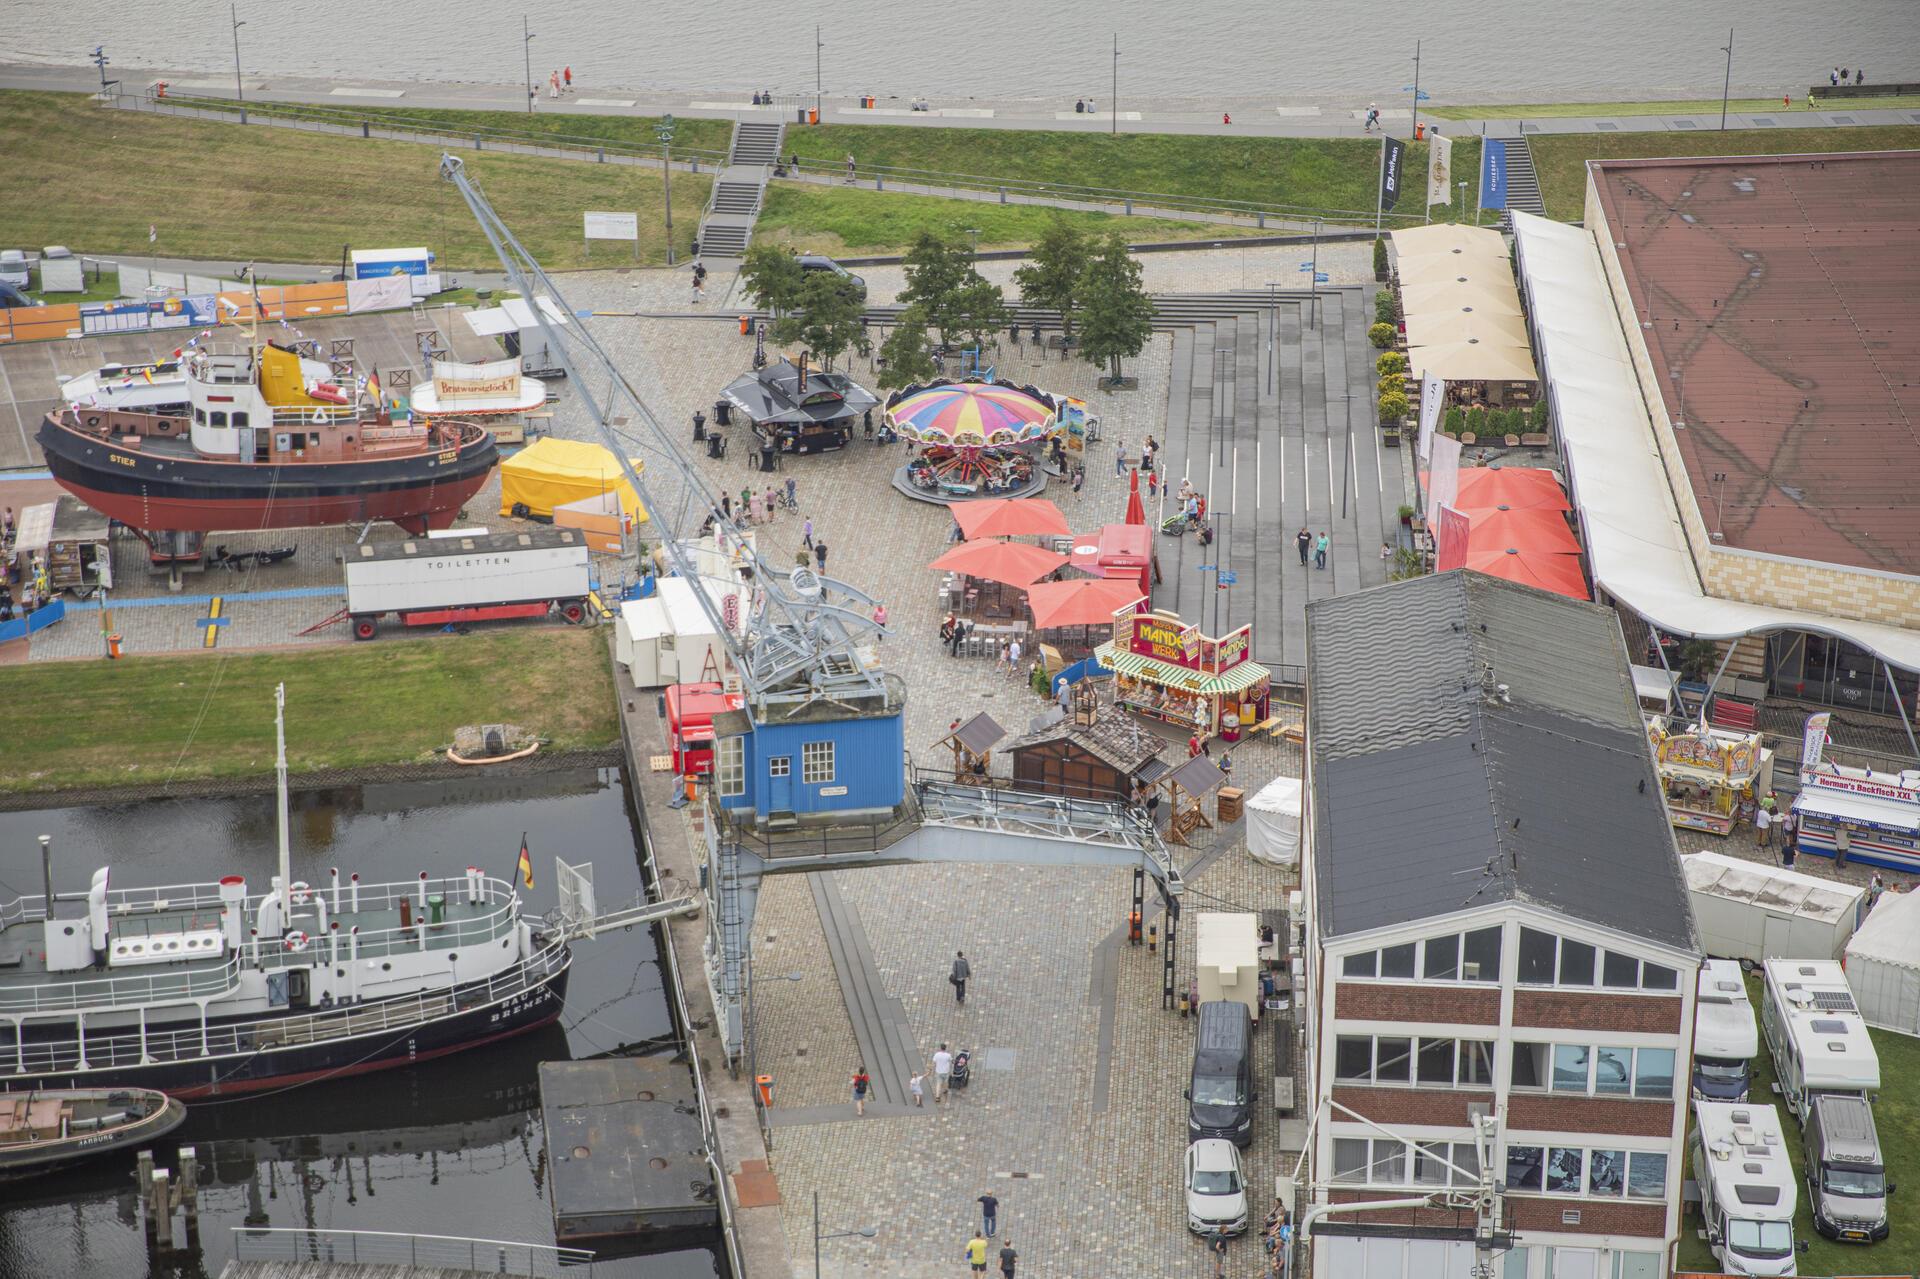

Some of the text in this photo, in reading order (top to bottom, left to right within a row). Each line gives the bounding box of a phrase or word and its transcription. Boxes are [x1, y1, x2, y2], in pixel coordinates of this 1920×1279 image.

[110, 454, 136, 467] STIER
[428, 557, 510, 569] TOILETTEN
[727, 598, 736, 630] EIS
[1140, 623, 1183, 649] MANDE
[1152, 643, 1178, 659] WERK
[1856, 784, 1895, 797] Backfisch
[1896, 790, 1912, 800] XXL
[491, 992, 551, 1022] BREMEN
[502, 993, 528, 1009] RAU
